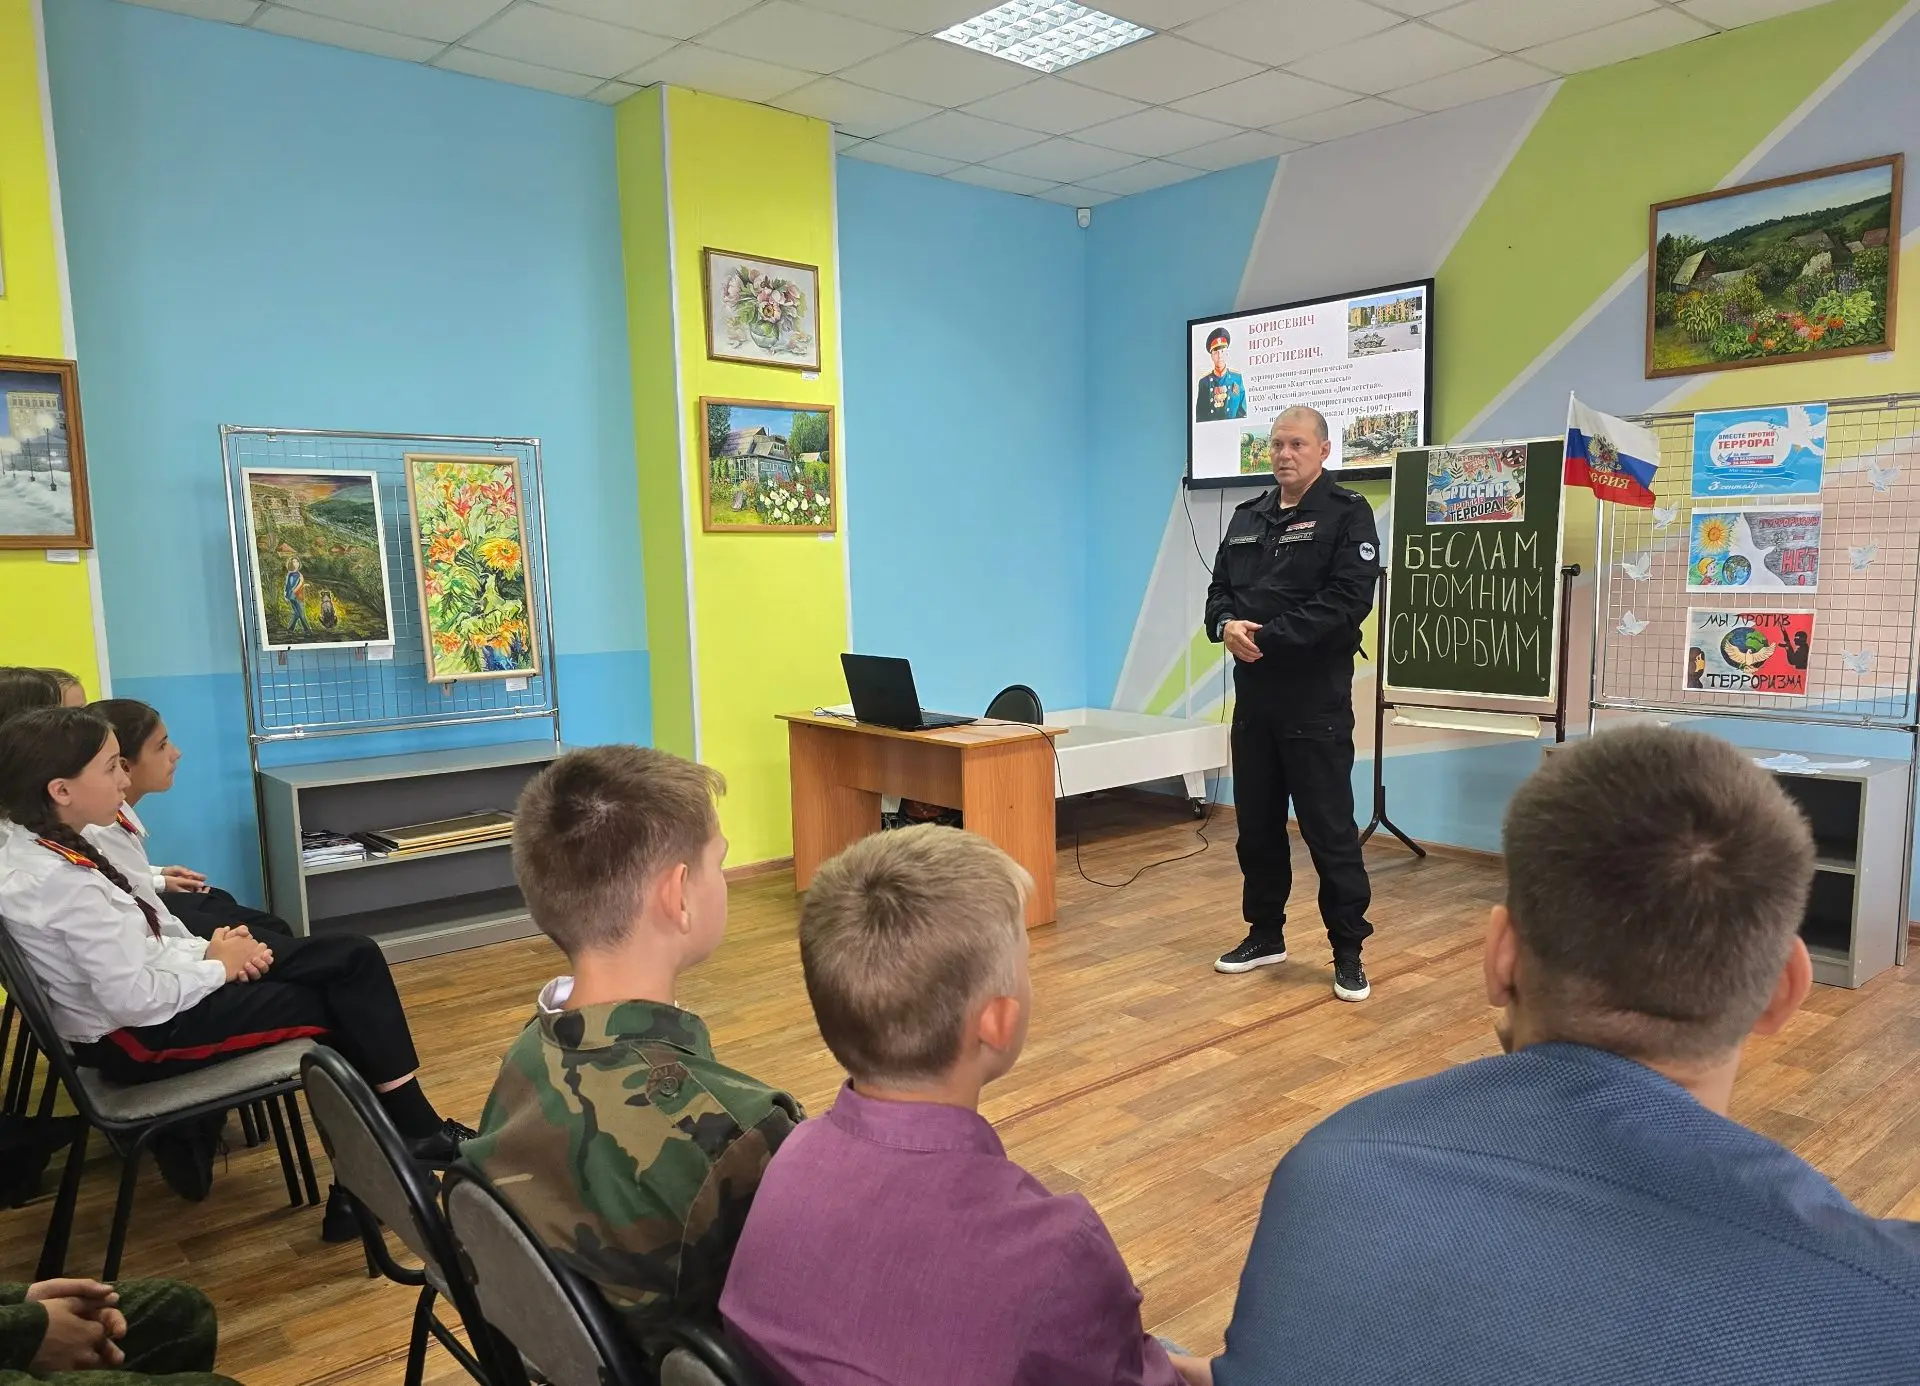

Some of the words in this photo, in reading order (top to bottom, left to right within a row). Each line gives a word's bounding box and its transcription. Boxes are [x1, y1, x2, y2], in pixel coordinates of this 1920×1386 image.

[1249, 315, 1315, 334] БОРИСЕВИЧ
[1248, 336, 1283, 350] ИГОРЬ
[1248, 346, 1323, 365] ГЕОРГИЕВИЧ,
[1374, 389, 1412, 400] операций
[1347, 405, 1383, 415] 1995-1997
[1718, 438, 1775, 449] ТЕРРОРА!
[1589, 472, 1631, 490] ССИЯ
[1450, 482, 1504, 499] РОССИЯ
[1449, 497, 1485, 511] ПРОТИВ
[1699, 613, 1729, 629] МЫ
[1732, 613, 1791, 627] ПРОТИВ
[1706, 673, 1802, 690] ТЕРРОРИЗМА
